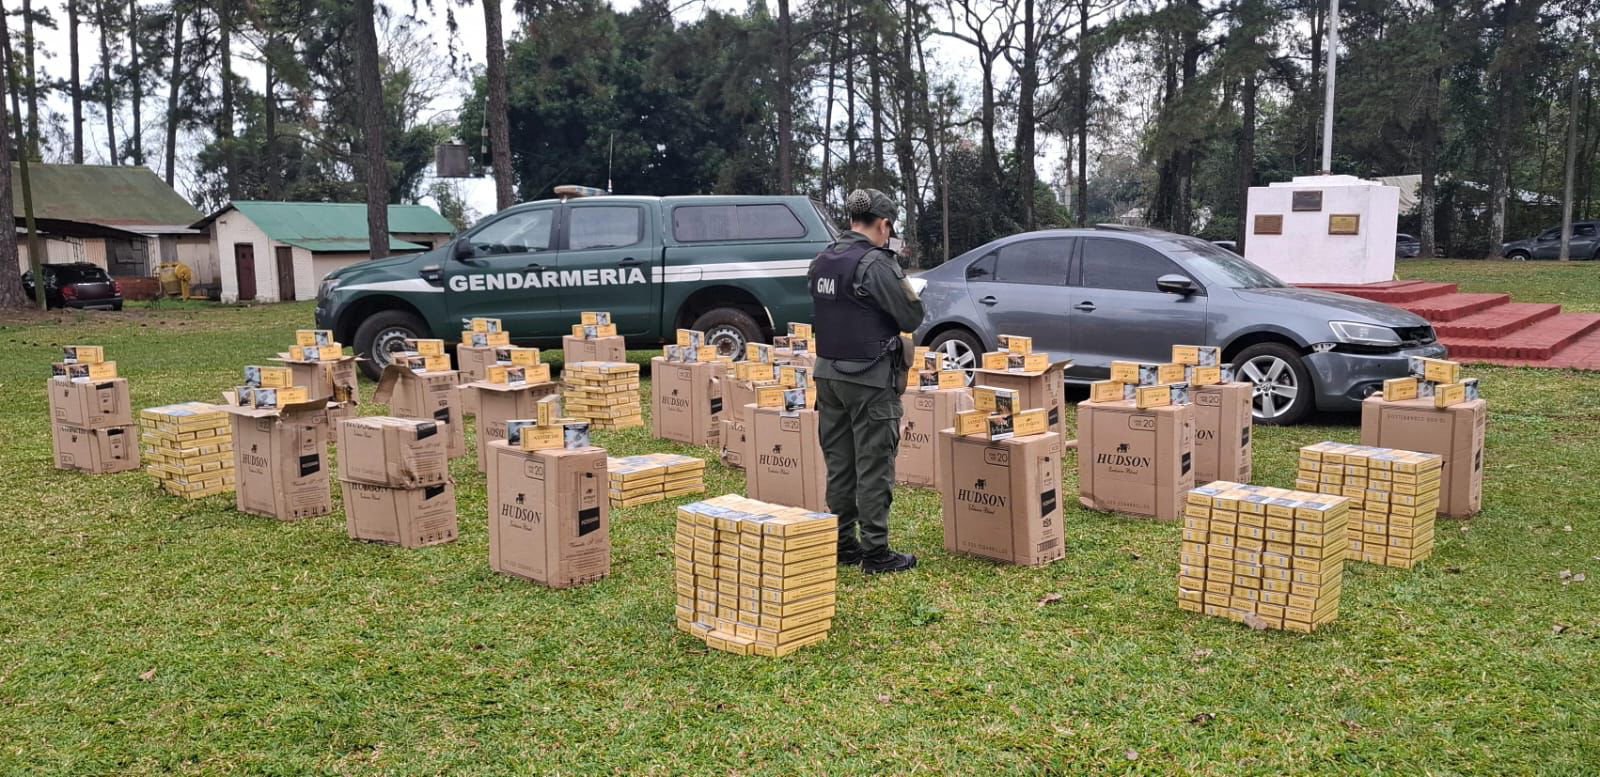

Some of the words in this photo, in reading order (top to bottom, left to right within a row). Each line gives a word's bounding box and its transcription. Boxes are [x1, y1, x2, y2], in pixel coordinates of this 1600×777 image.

[449, 267, 646, 293] GENDARMERIA
[817, 277, 835, 295] GNA
[662, 395, 690, 408] HUDSON
[1143, 419, 1154, 428] 20
[903, 430, 930, 444] DSON
[241, 453, 268, 469] HUDSON
[759, 454, 799, 469] HUDSON
[997, 452, 1008, 463] 20
[1096, 453, 1152, 468] HUDSON
[958, 488, 1008, 508] HUDSON
[502, 503, 543, 525] HUDSON
